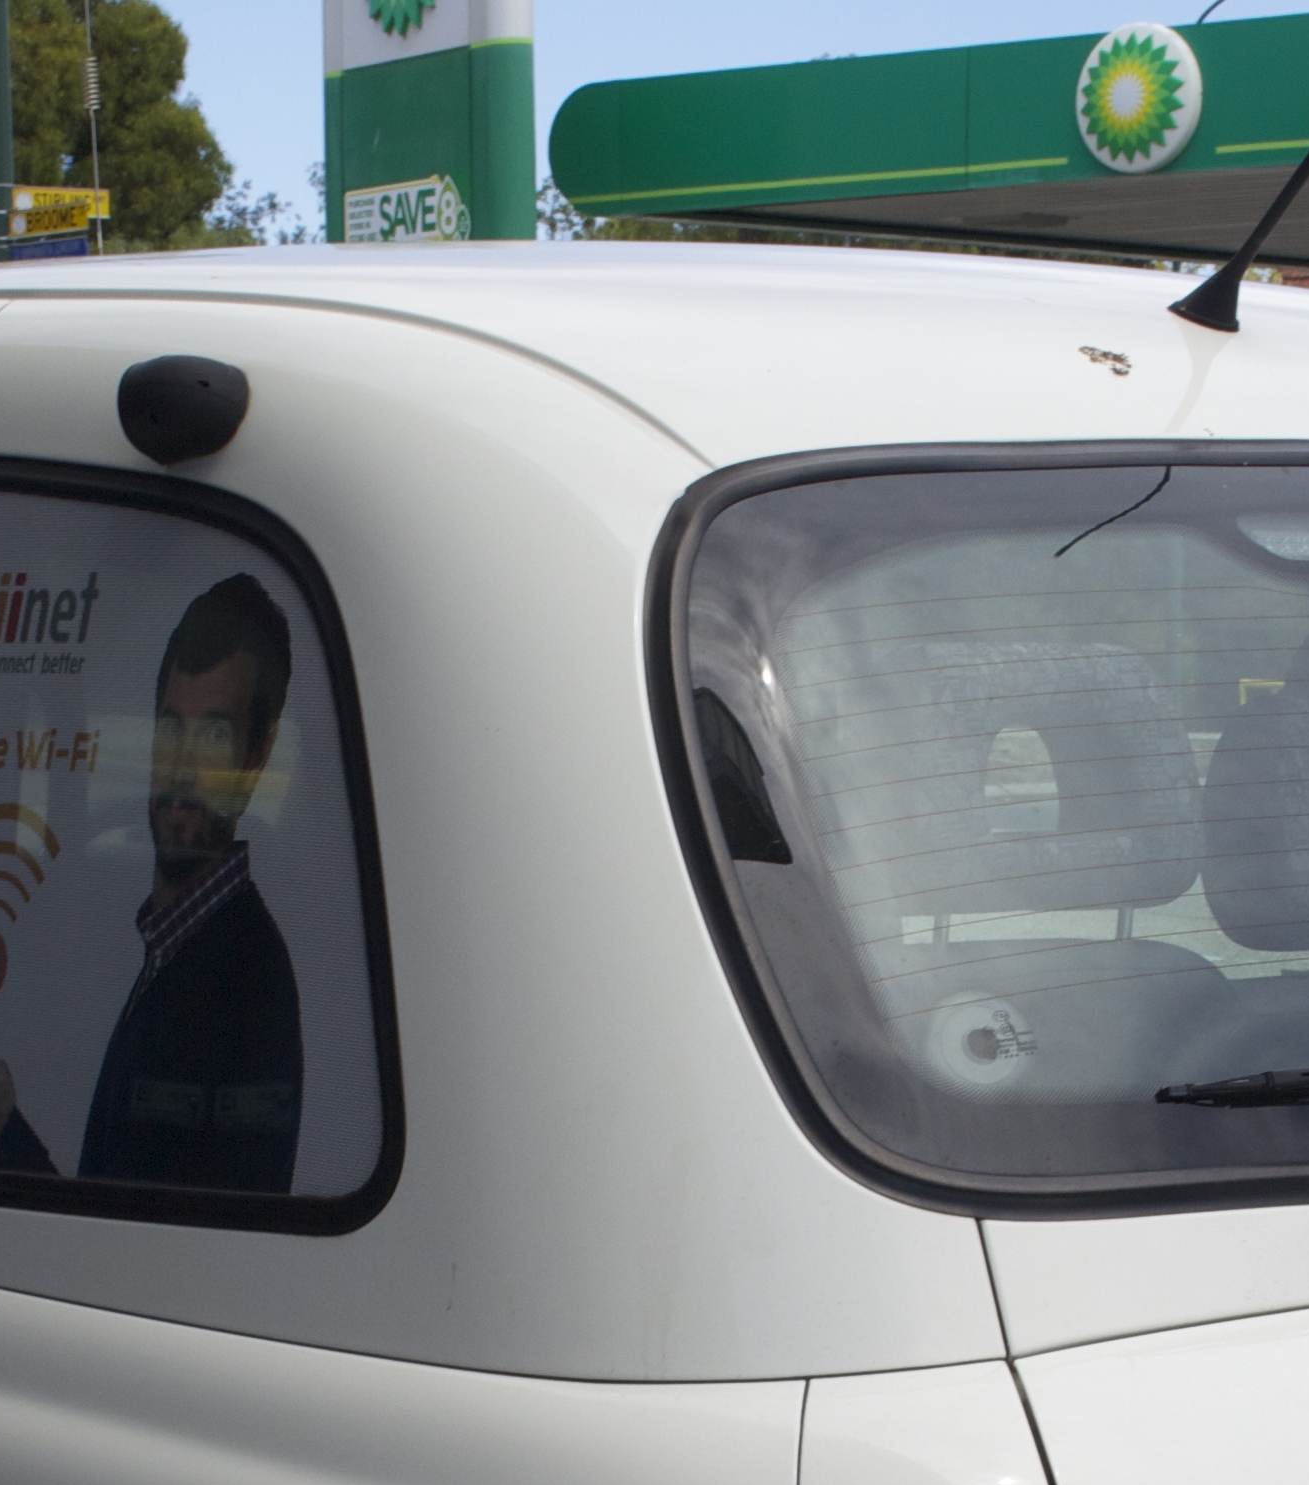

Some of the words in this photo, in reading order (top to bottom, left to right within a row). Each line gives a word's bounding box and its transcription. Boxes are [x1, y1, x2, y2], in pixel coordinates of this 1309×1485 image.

[26, 206, 78, 232] BROOME
[379, 187, 436, 240] SAVE
[40, 653, 86, 674] better
[16, 730, 100, 774] Wi-Fi
